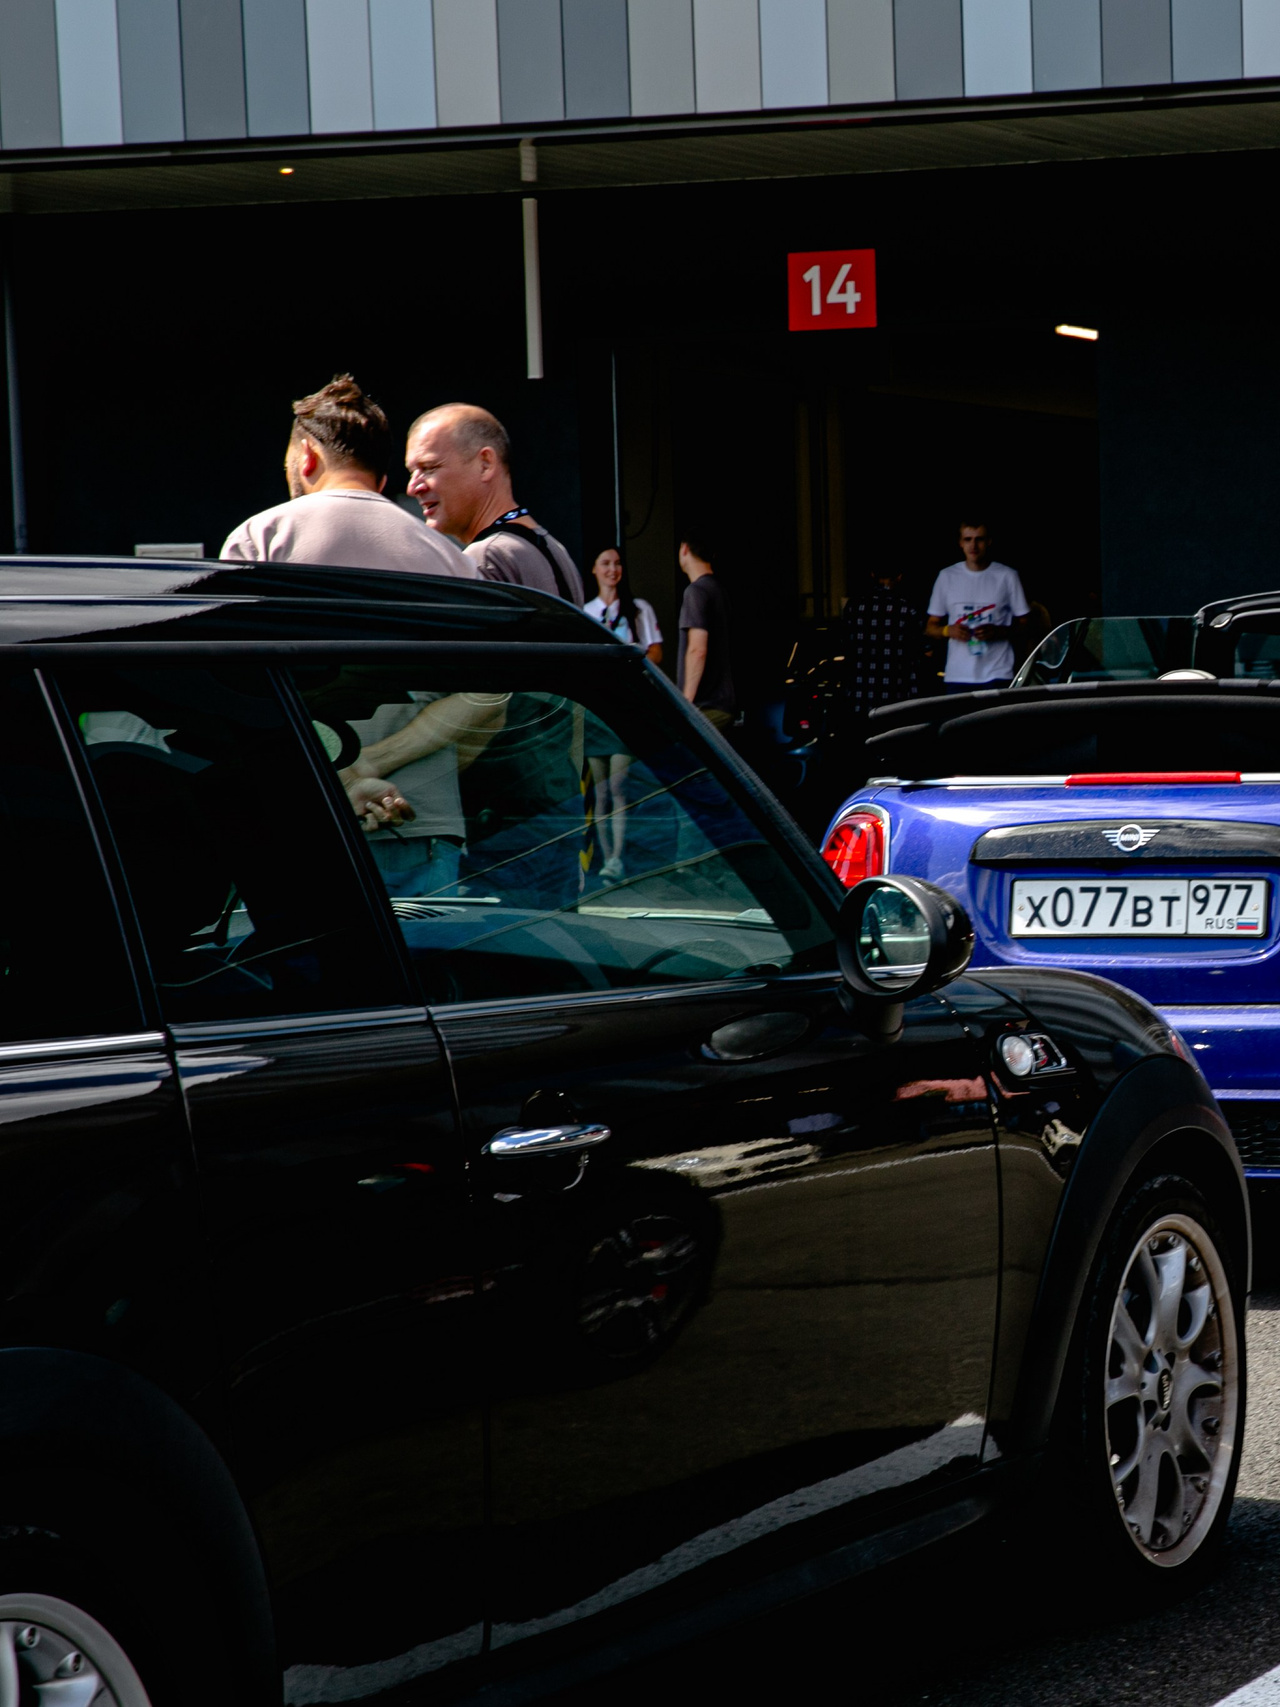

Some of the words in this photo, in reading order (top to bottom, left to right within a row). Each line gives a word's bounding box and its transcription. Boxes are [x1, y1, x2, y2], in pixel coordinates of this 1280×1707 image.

[802, 263, 861, 316] 14
[1120, 833, 1140, 842] MINI
[1191, 884, 1253, 915] 977
[1204, 918, 1235, 929] RUS
